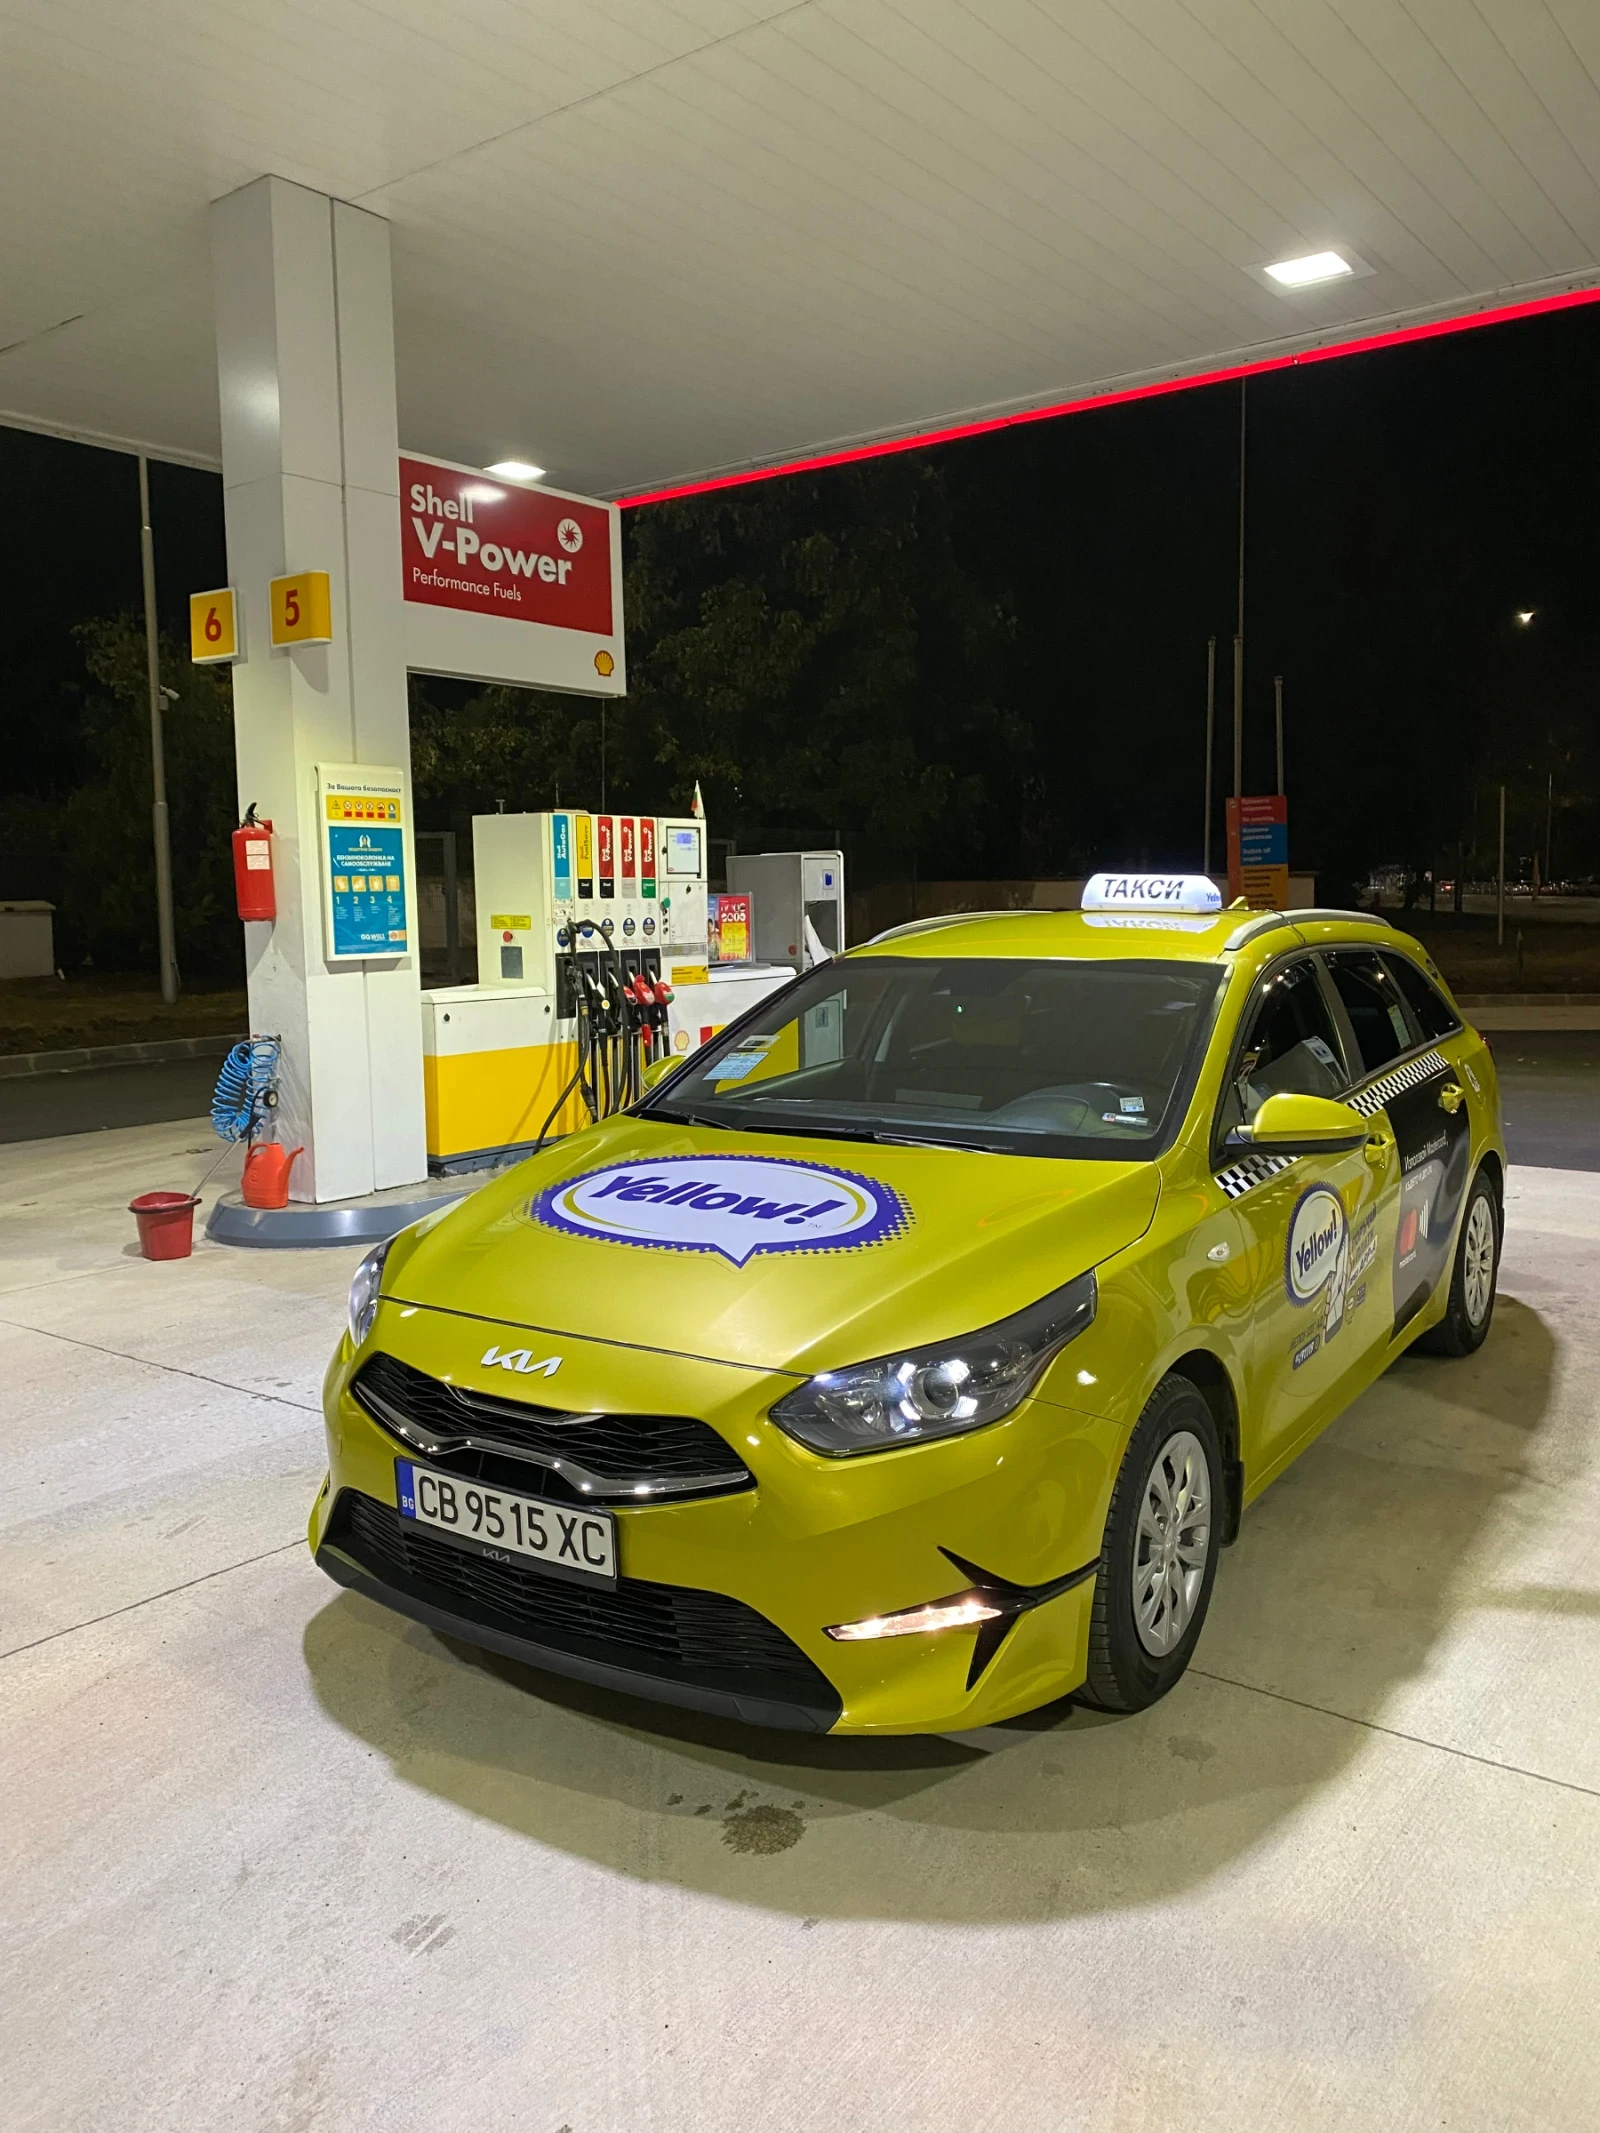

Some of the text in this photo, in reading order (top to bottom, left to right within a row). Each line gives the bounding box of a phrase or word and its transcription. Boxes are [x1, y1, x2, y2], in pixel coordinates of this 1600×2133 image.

[410, 484, 473, 523] Shell
[412, 517, 572, 585] V-Power
[413, 567, 521, 601] Performance Fuels
[285, 588, 300, 627] 5
[205, 607, 222, 642] 6
[336, 896, 340, 904] 1
[353, 896, 359, 904] 2
[369, 896, 375, 904] 3
[387, 895, 392, 904] 4
[1104, 878, 1185, 900] ТАКСИ
[588, 1175, 848, 1225] Yellow!
[1296, 1208, 1337, 1278] Yellow!
[481, 1346, 563, 1378] KIA
[402, 1495, 414, 1510] BG
[418, 1475, 605, 1567] CB 9515 XC
[483, 1549, 510, 1563] KIA
